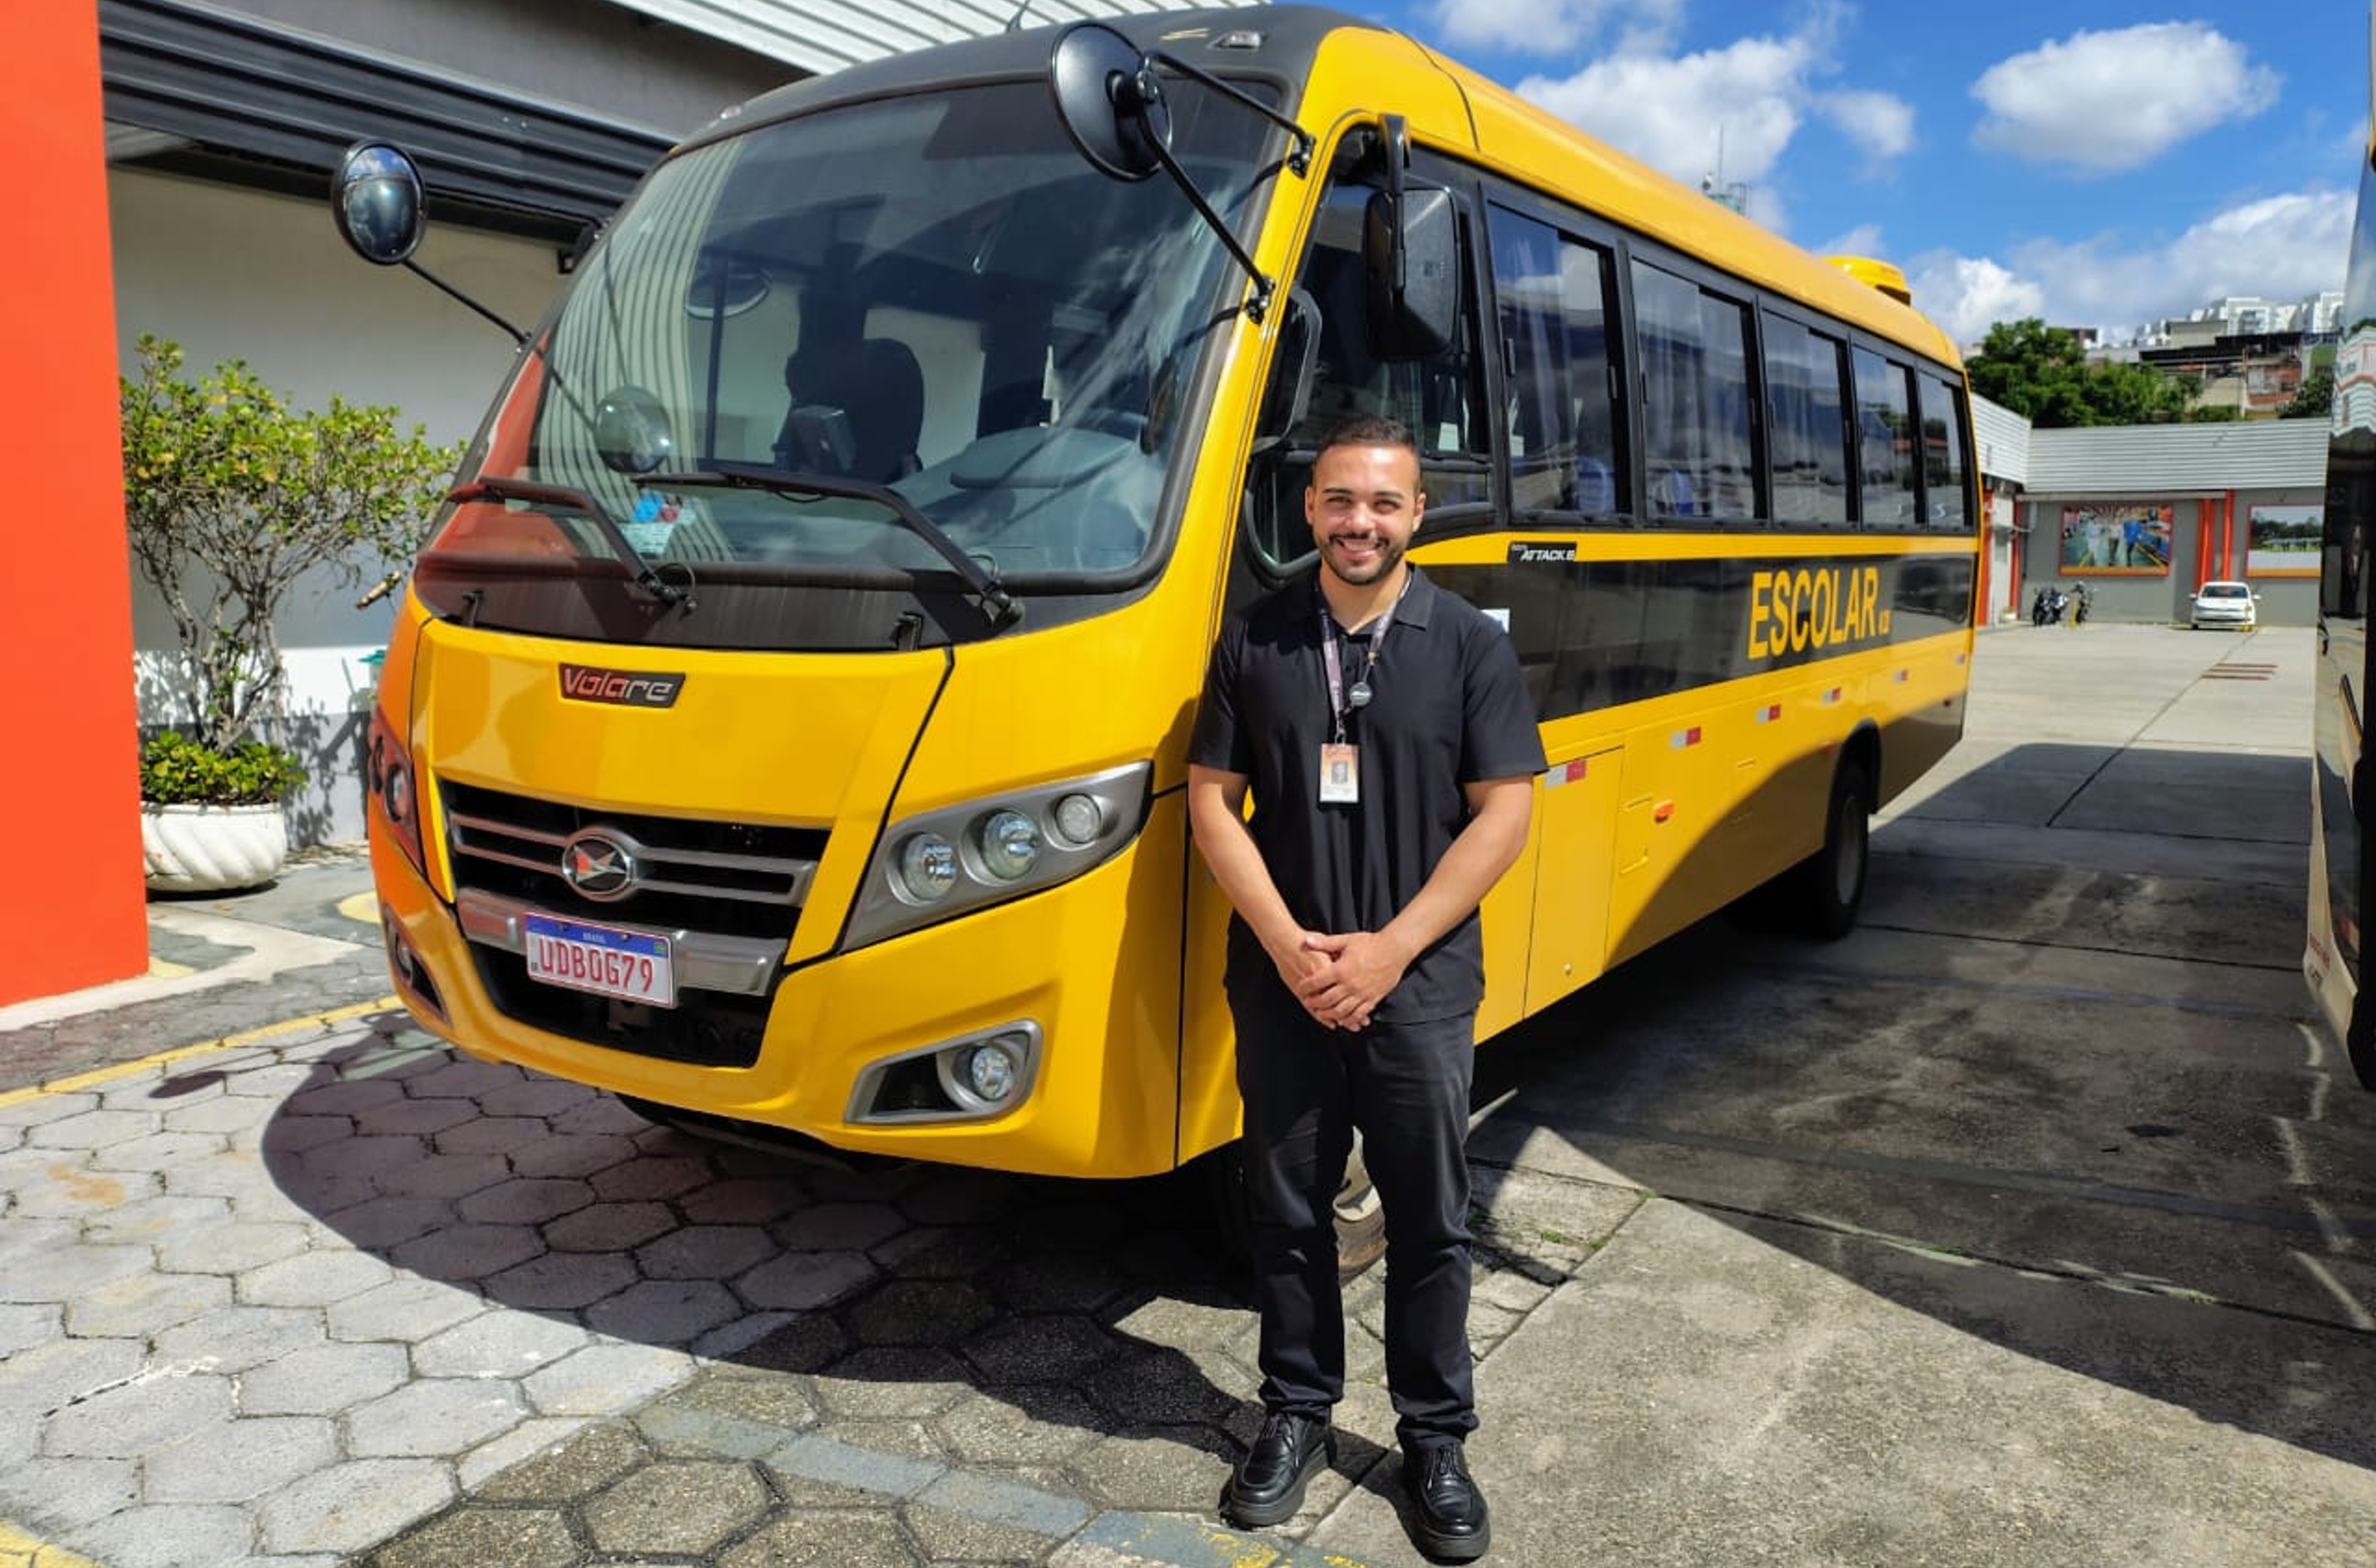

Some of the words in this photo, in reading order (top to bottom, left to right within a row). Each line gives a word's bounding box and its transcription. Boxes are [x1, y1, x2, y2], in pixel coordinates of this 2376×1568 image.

[1520, 549, 1565, 562] ATTACK
[1749, 567, 1879, 659] ESCOLAR
[564, 668, 673, 701] Volare
